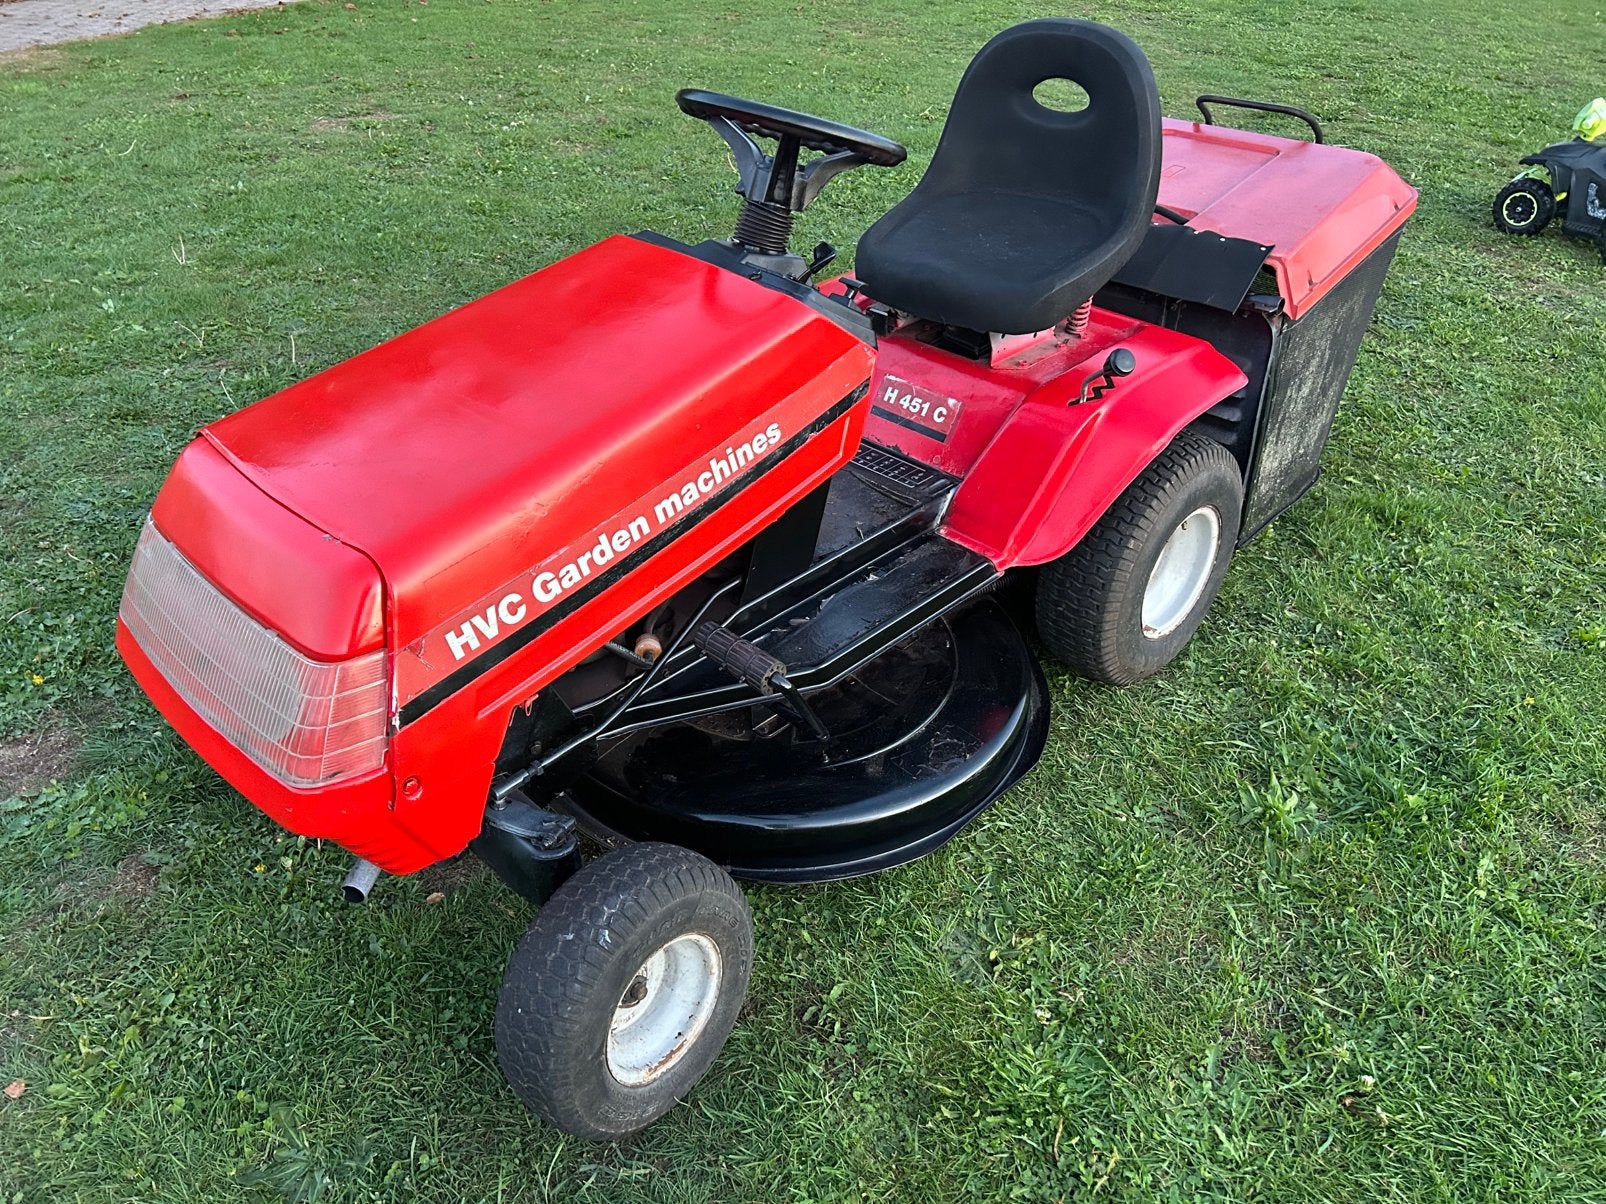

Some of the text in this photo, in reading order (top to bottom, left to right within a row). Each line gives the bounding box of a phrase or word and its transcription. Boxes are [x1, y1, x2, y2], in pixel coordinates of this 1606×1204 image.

[884, 388, 946, 422] H 451 C
[445, 594, 526, 660] HVC
[533, 516, 650, 602] Garden
[656, 422, 781, 525] machines
